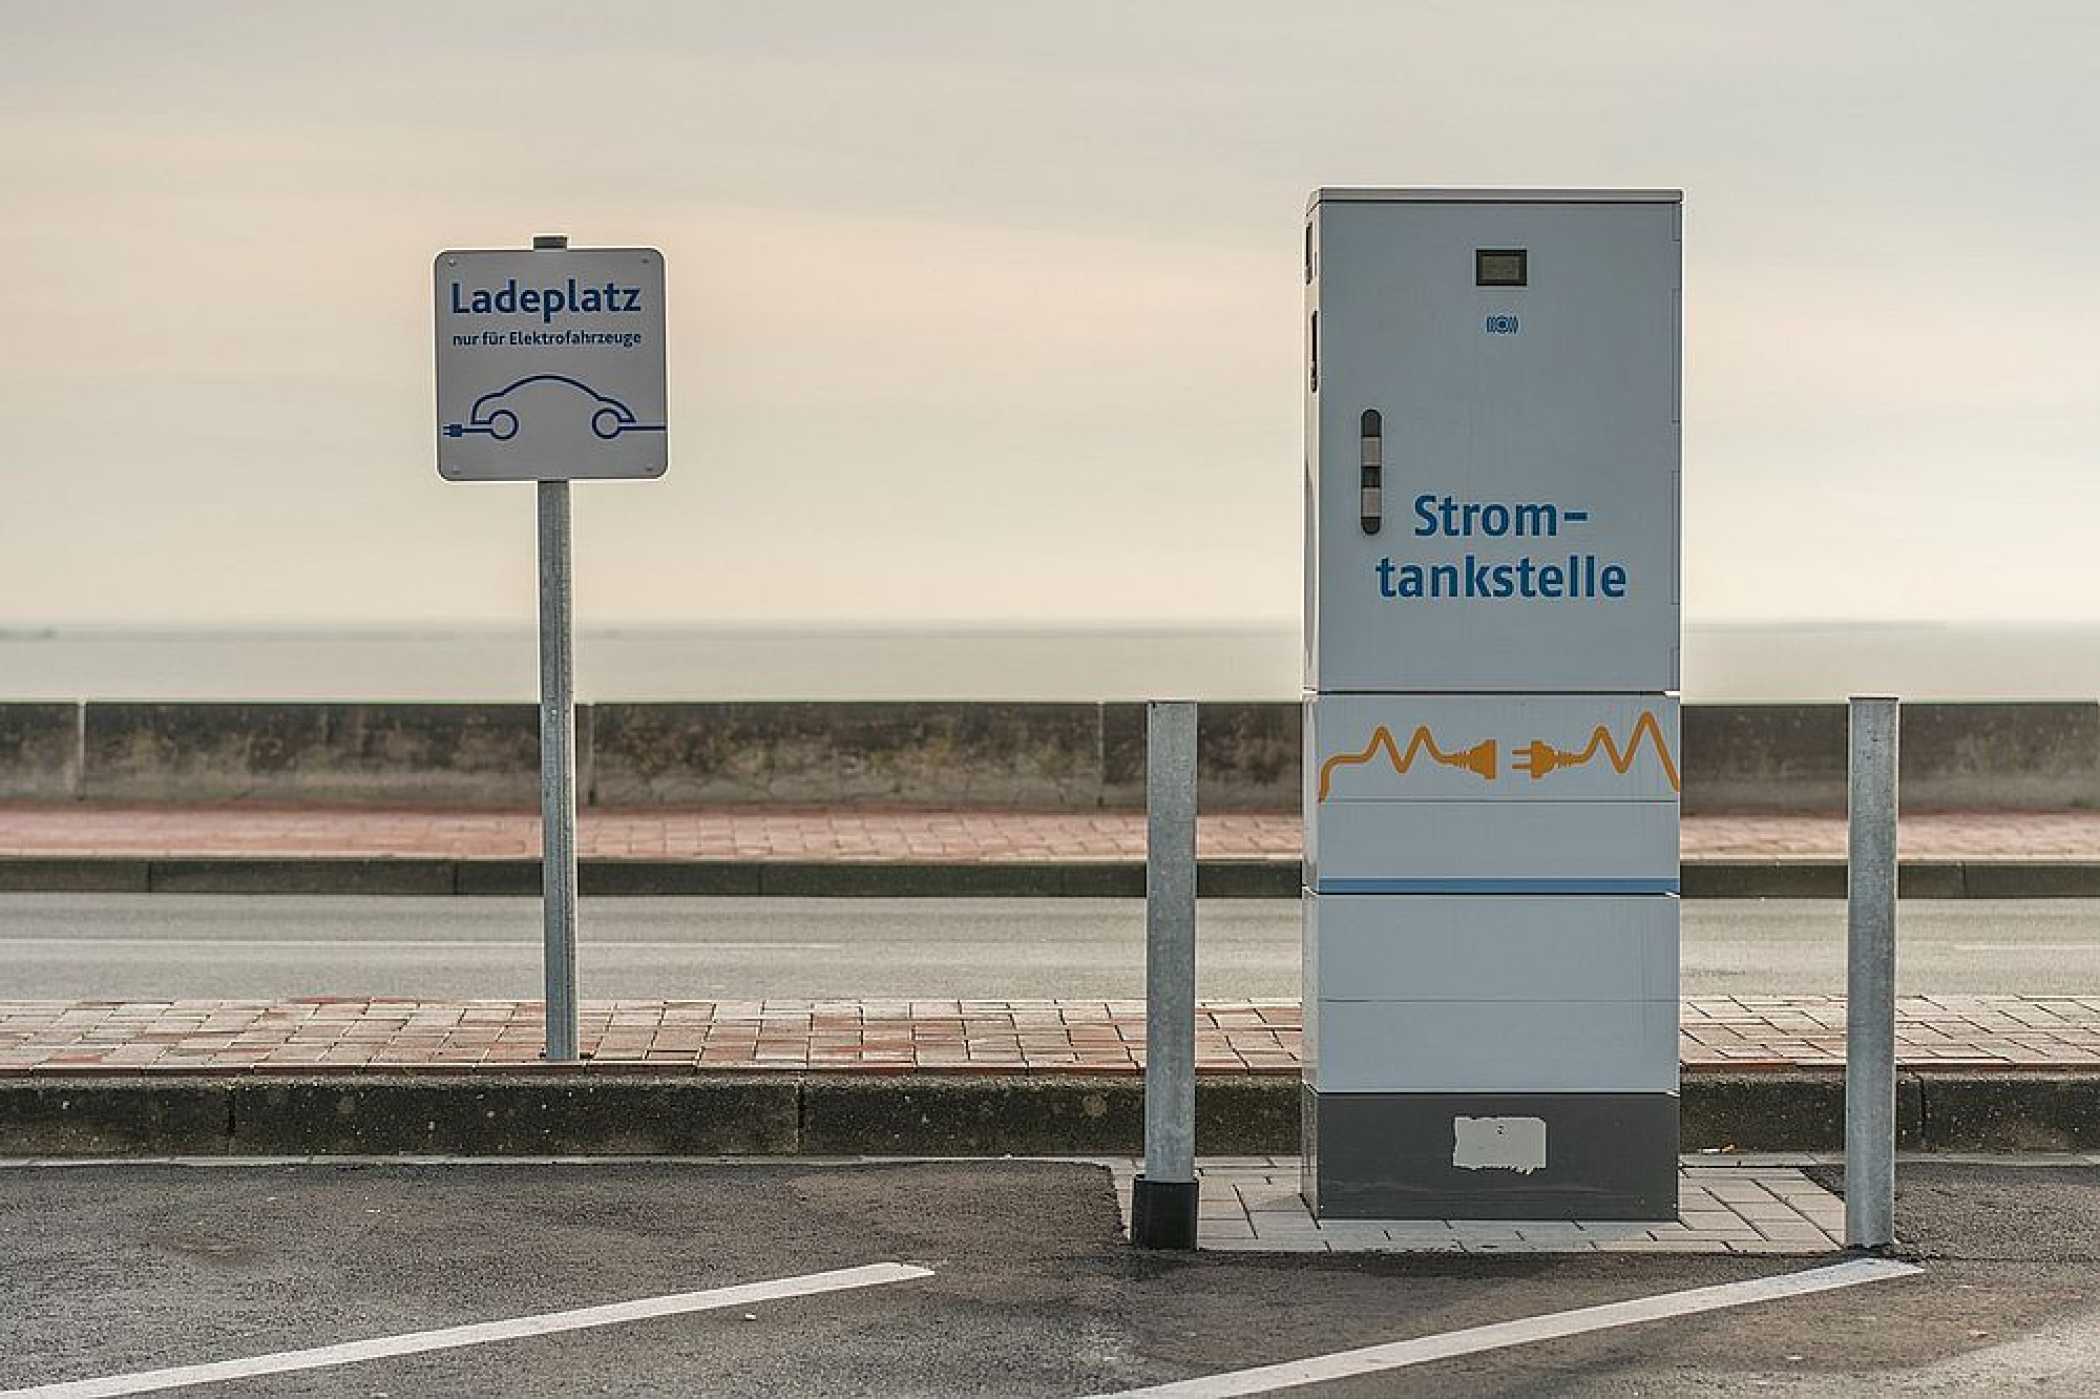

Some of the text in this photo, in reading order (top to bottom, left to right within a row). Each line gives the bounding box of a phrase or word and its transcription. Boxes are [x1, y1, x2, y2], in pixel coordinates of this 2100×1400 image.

[452, 279, 641, 323] Ladeplatz
[453, 330, 642, 347] nur für Elektrofahrzeuge
[1414, 494, 1588, 537] Strom-
[1376, 555, 1626, 598] tankstelle
